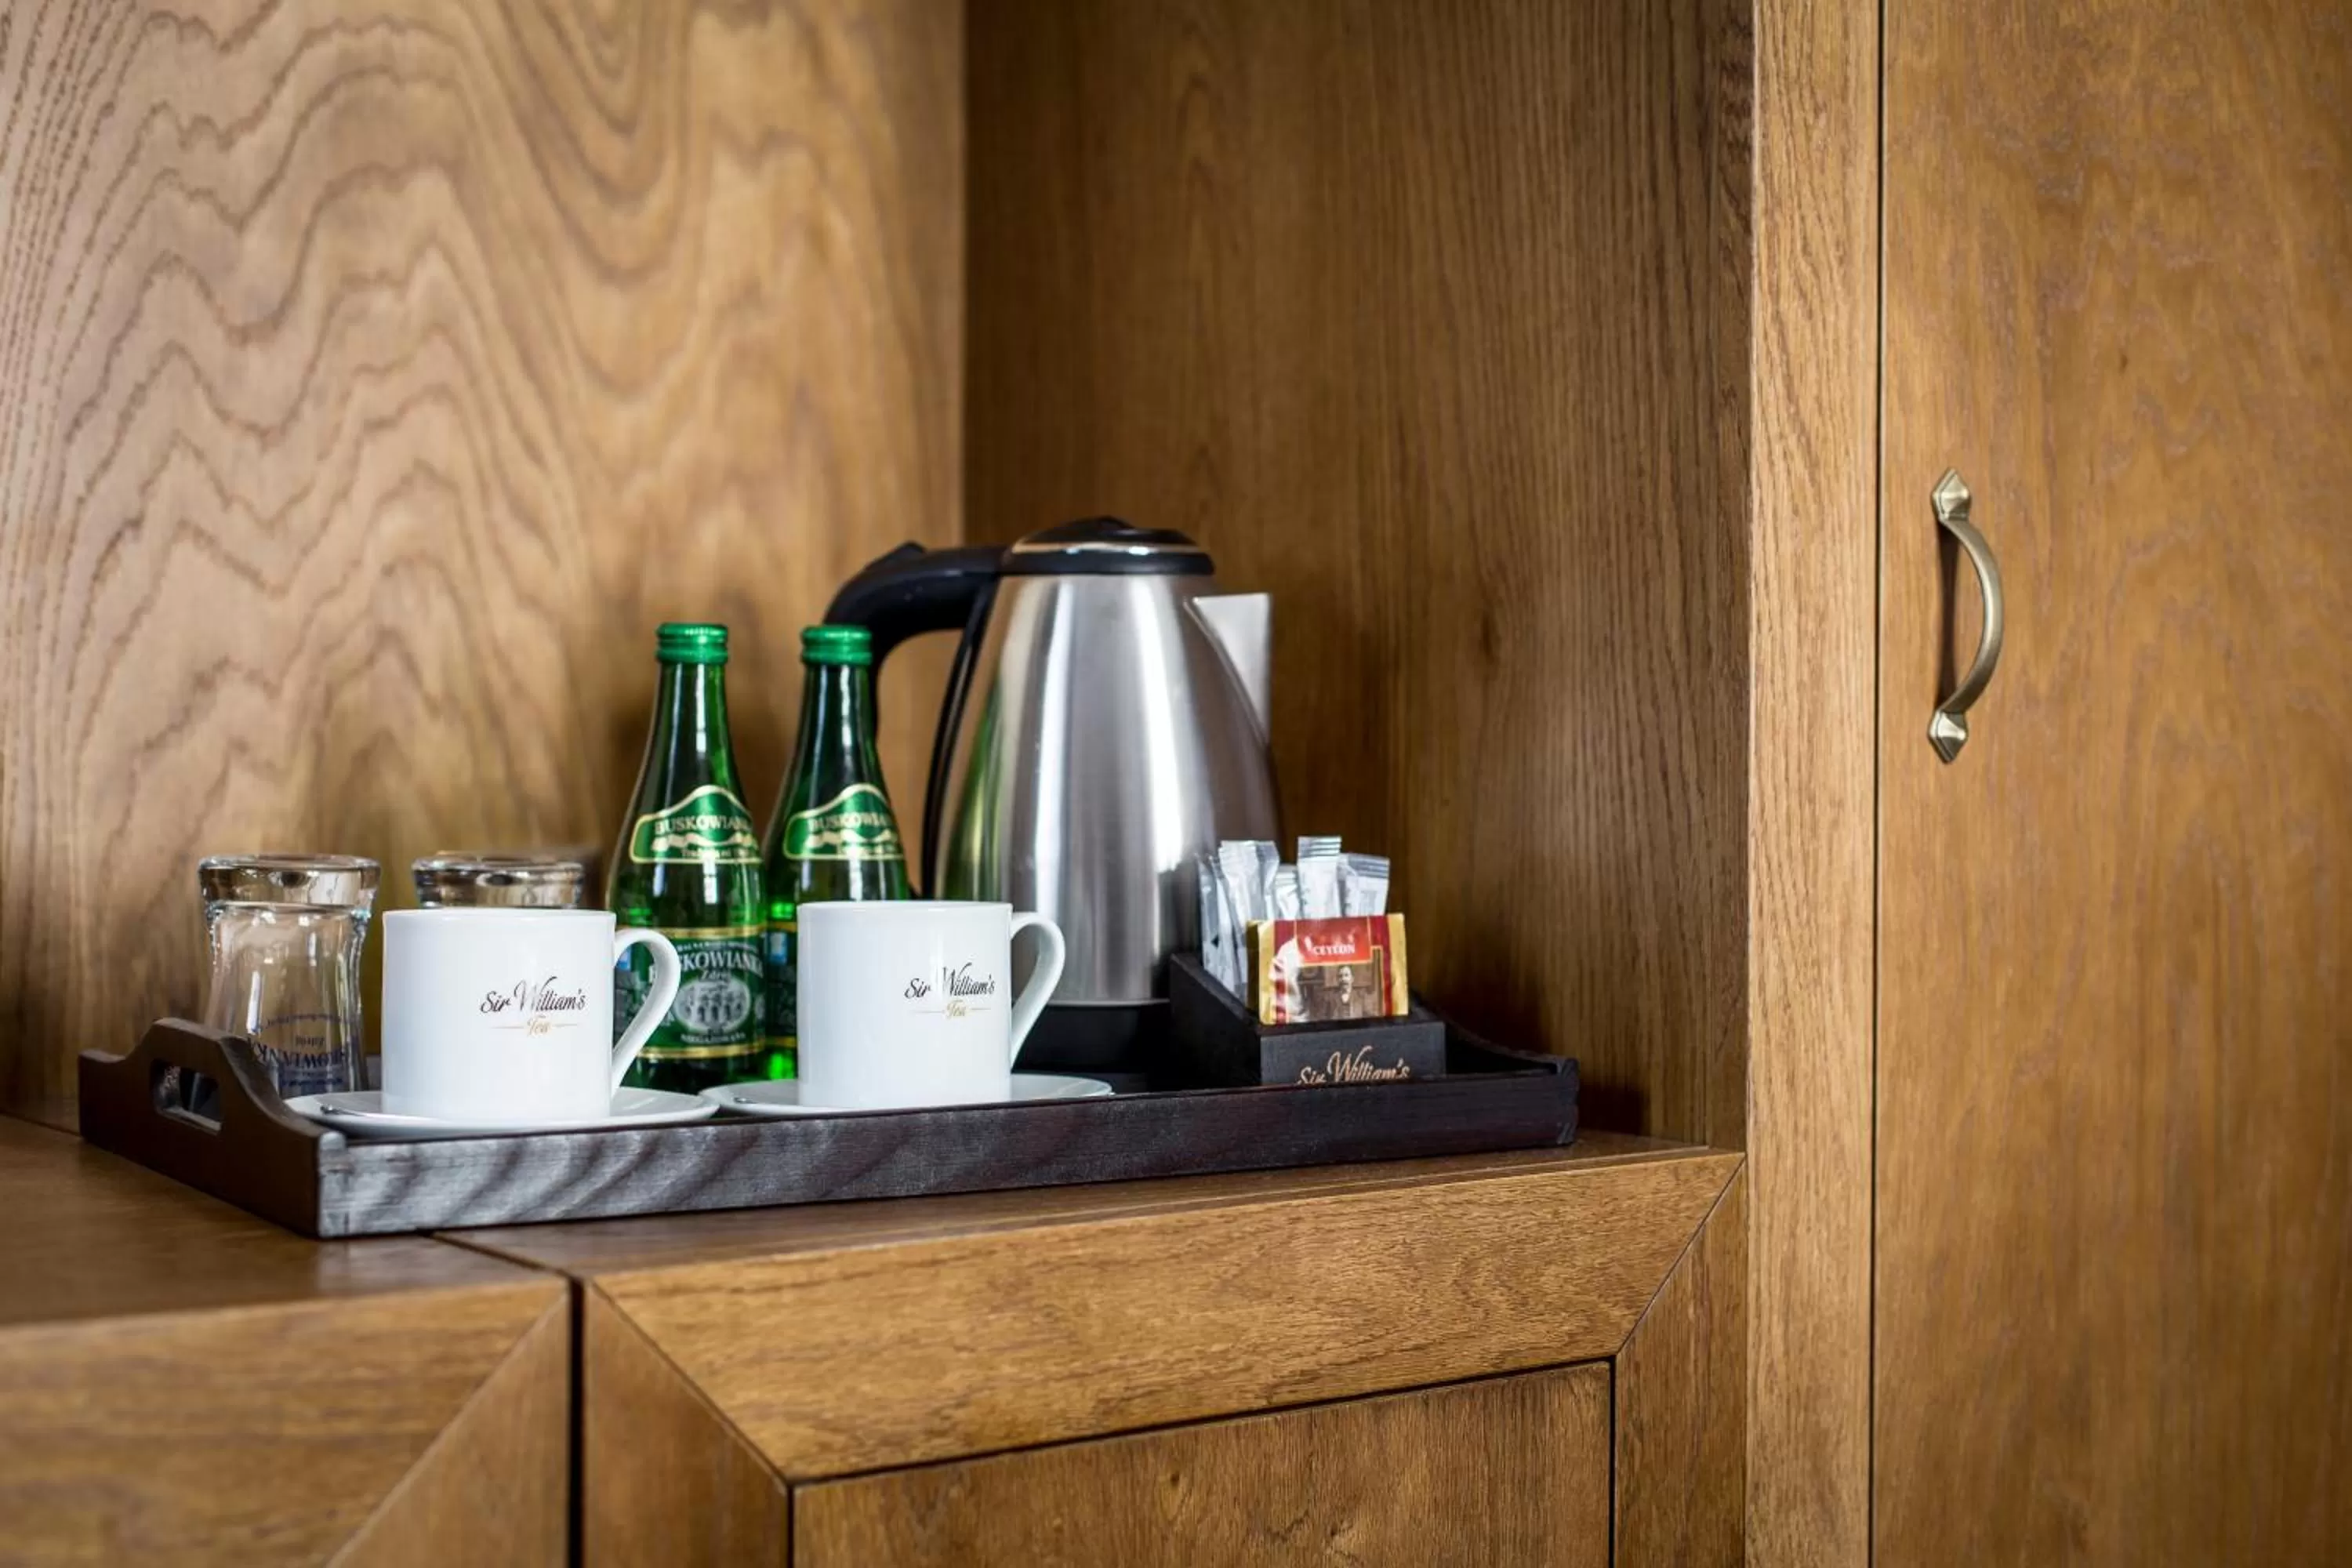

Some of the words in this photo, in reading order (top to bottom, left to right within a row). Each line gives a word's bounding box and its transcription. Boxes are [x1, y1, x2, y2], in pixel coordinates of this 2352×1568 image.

[480, 990, 511, 1014] Sir
[514, 975, 586, 1012] William's
[904, 977, 931, 999] Sir
[1297, 1065, 1327, 1085] Sir
[1327, 1044, 1410, 1083] William's
